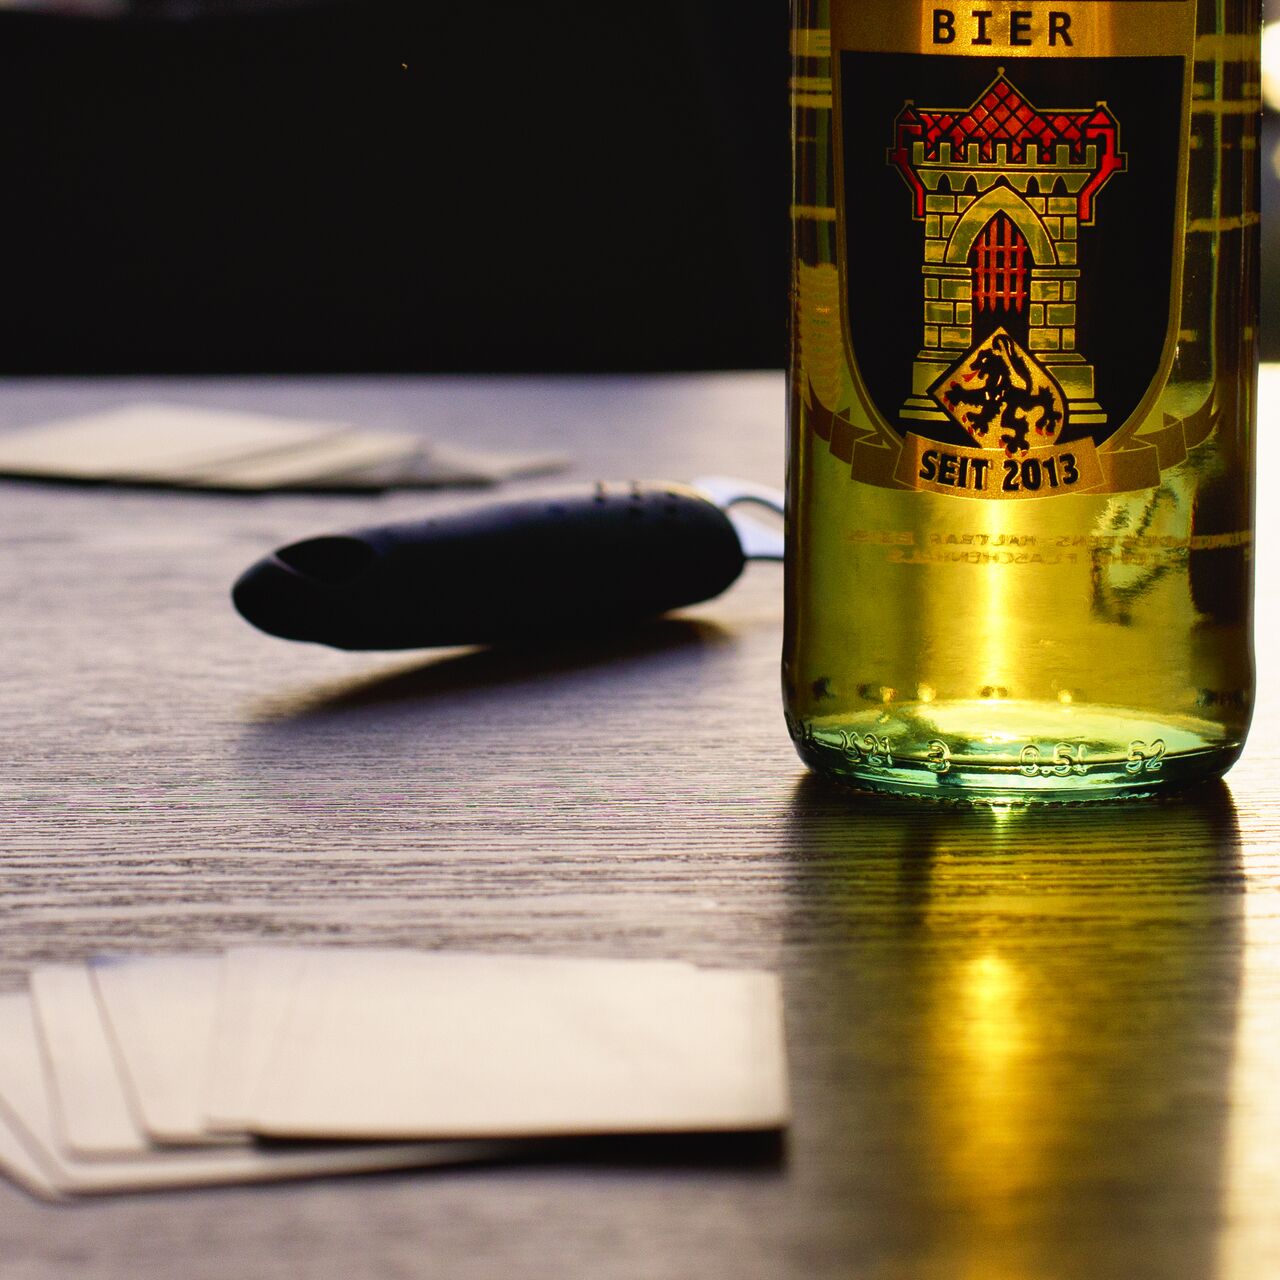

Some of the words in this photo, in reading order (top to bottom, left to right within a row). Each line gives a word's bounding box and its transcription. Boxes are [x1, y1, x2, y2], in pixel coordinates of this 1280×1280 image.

[932, 9, 1074, 47] BIER
[918, 450, 992, 491] SEIT
[1001, 453, 1081, 492] 2013
